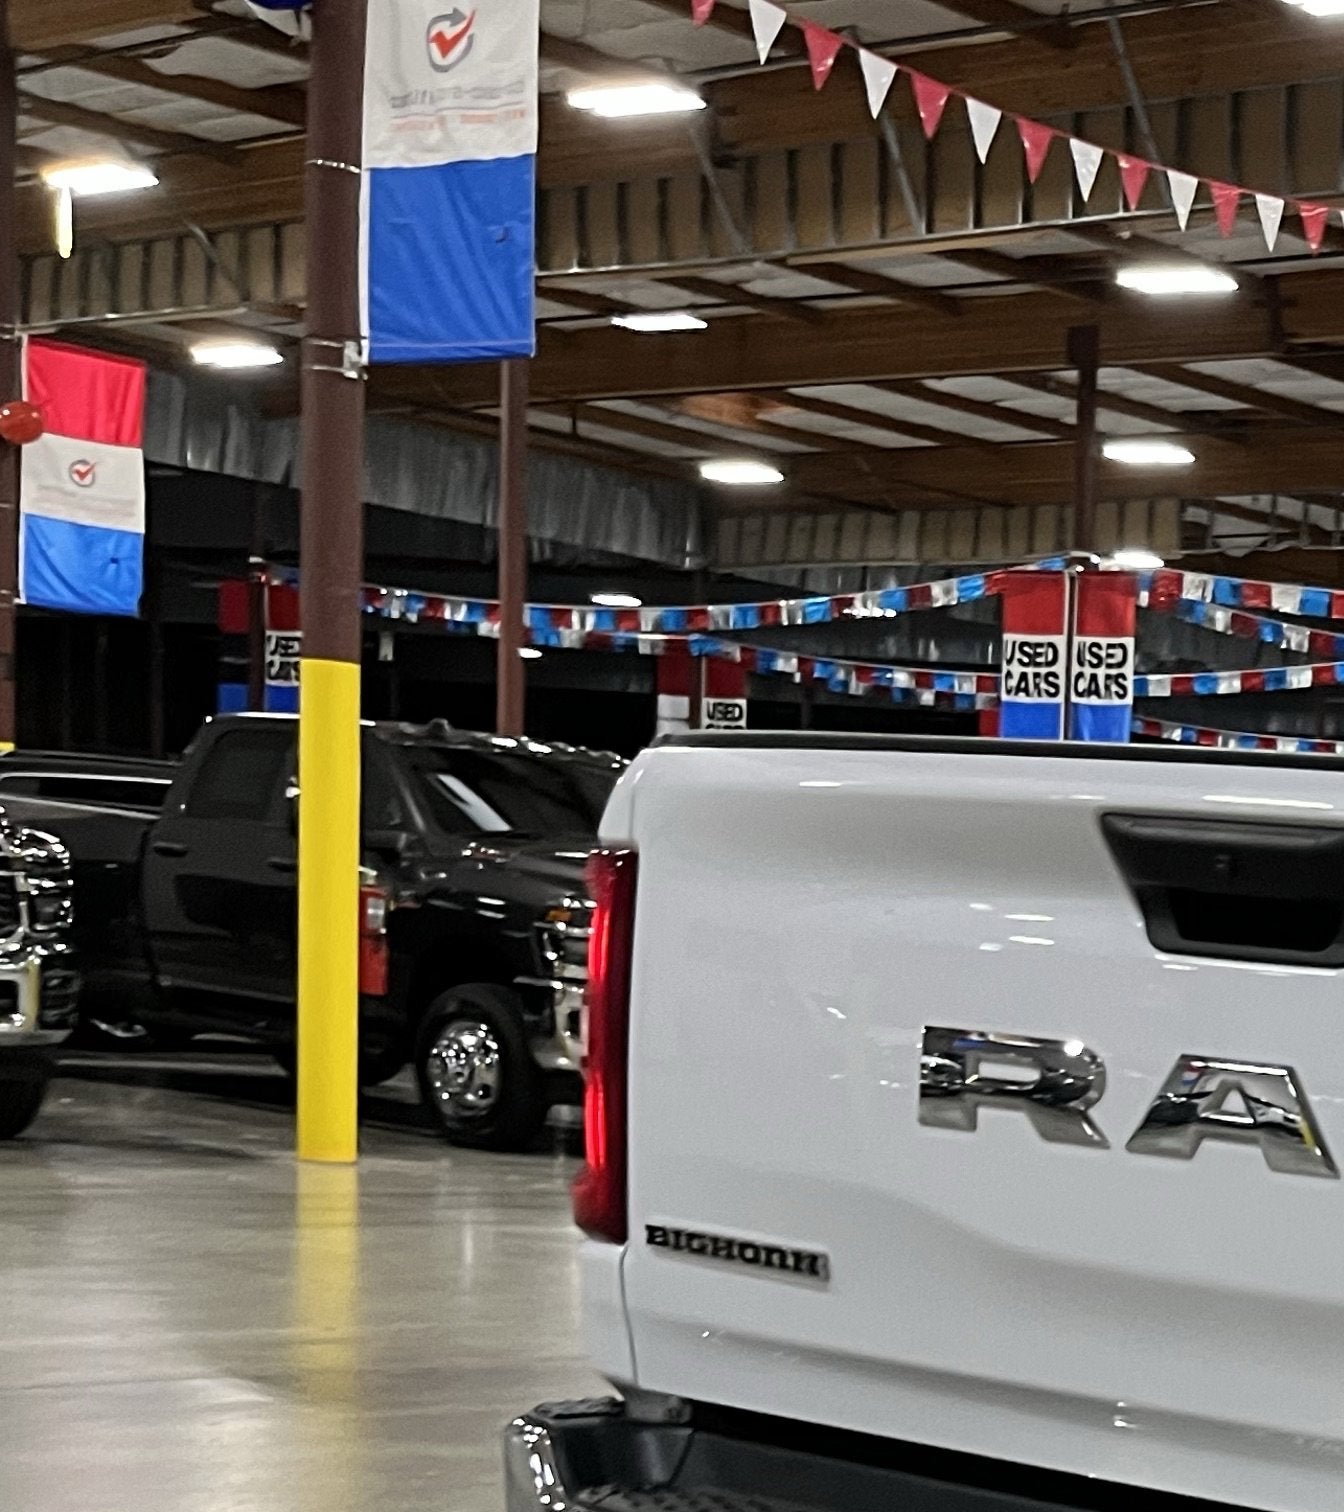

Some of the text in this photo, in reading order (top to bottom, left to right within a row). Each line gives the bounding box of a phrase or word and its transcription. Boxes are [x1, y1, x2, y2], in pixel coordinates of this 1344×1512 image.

[1004, 640, 1059, 668] USED
[1077, 641, 1128, 669] USED
[1004, 670, 1060, 698] CARS
[1073, 671, 1128, 700] CARS
[707, 701, 743, 722] USED
[645, 1224, 829, 1282] BIGHORN
